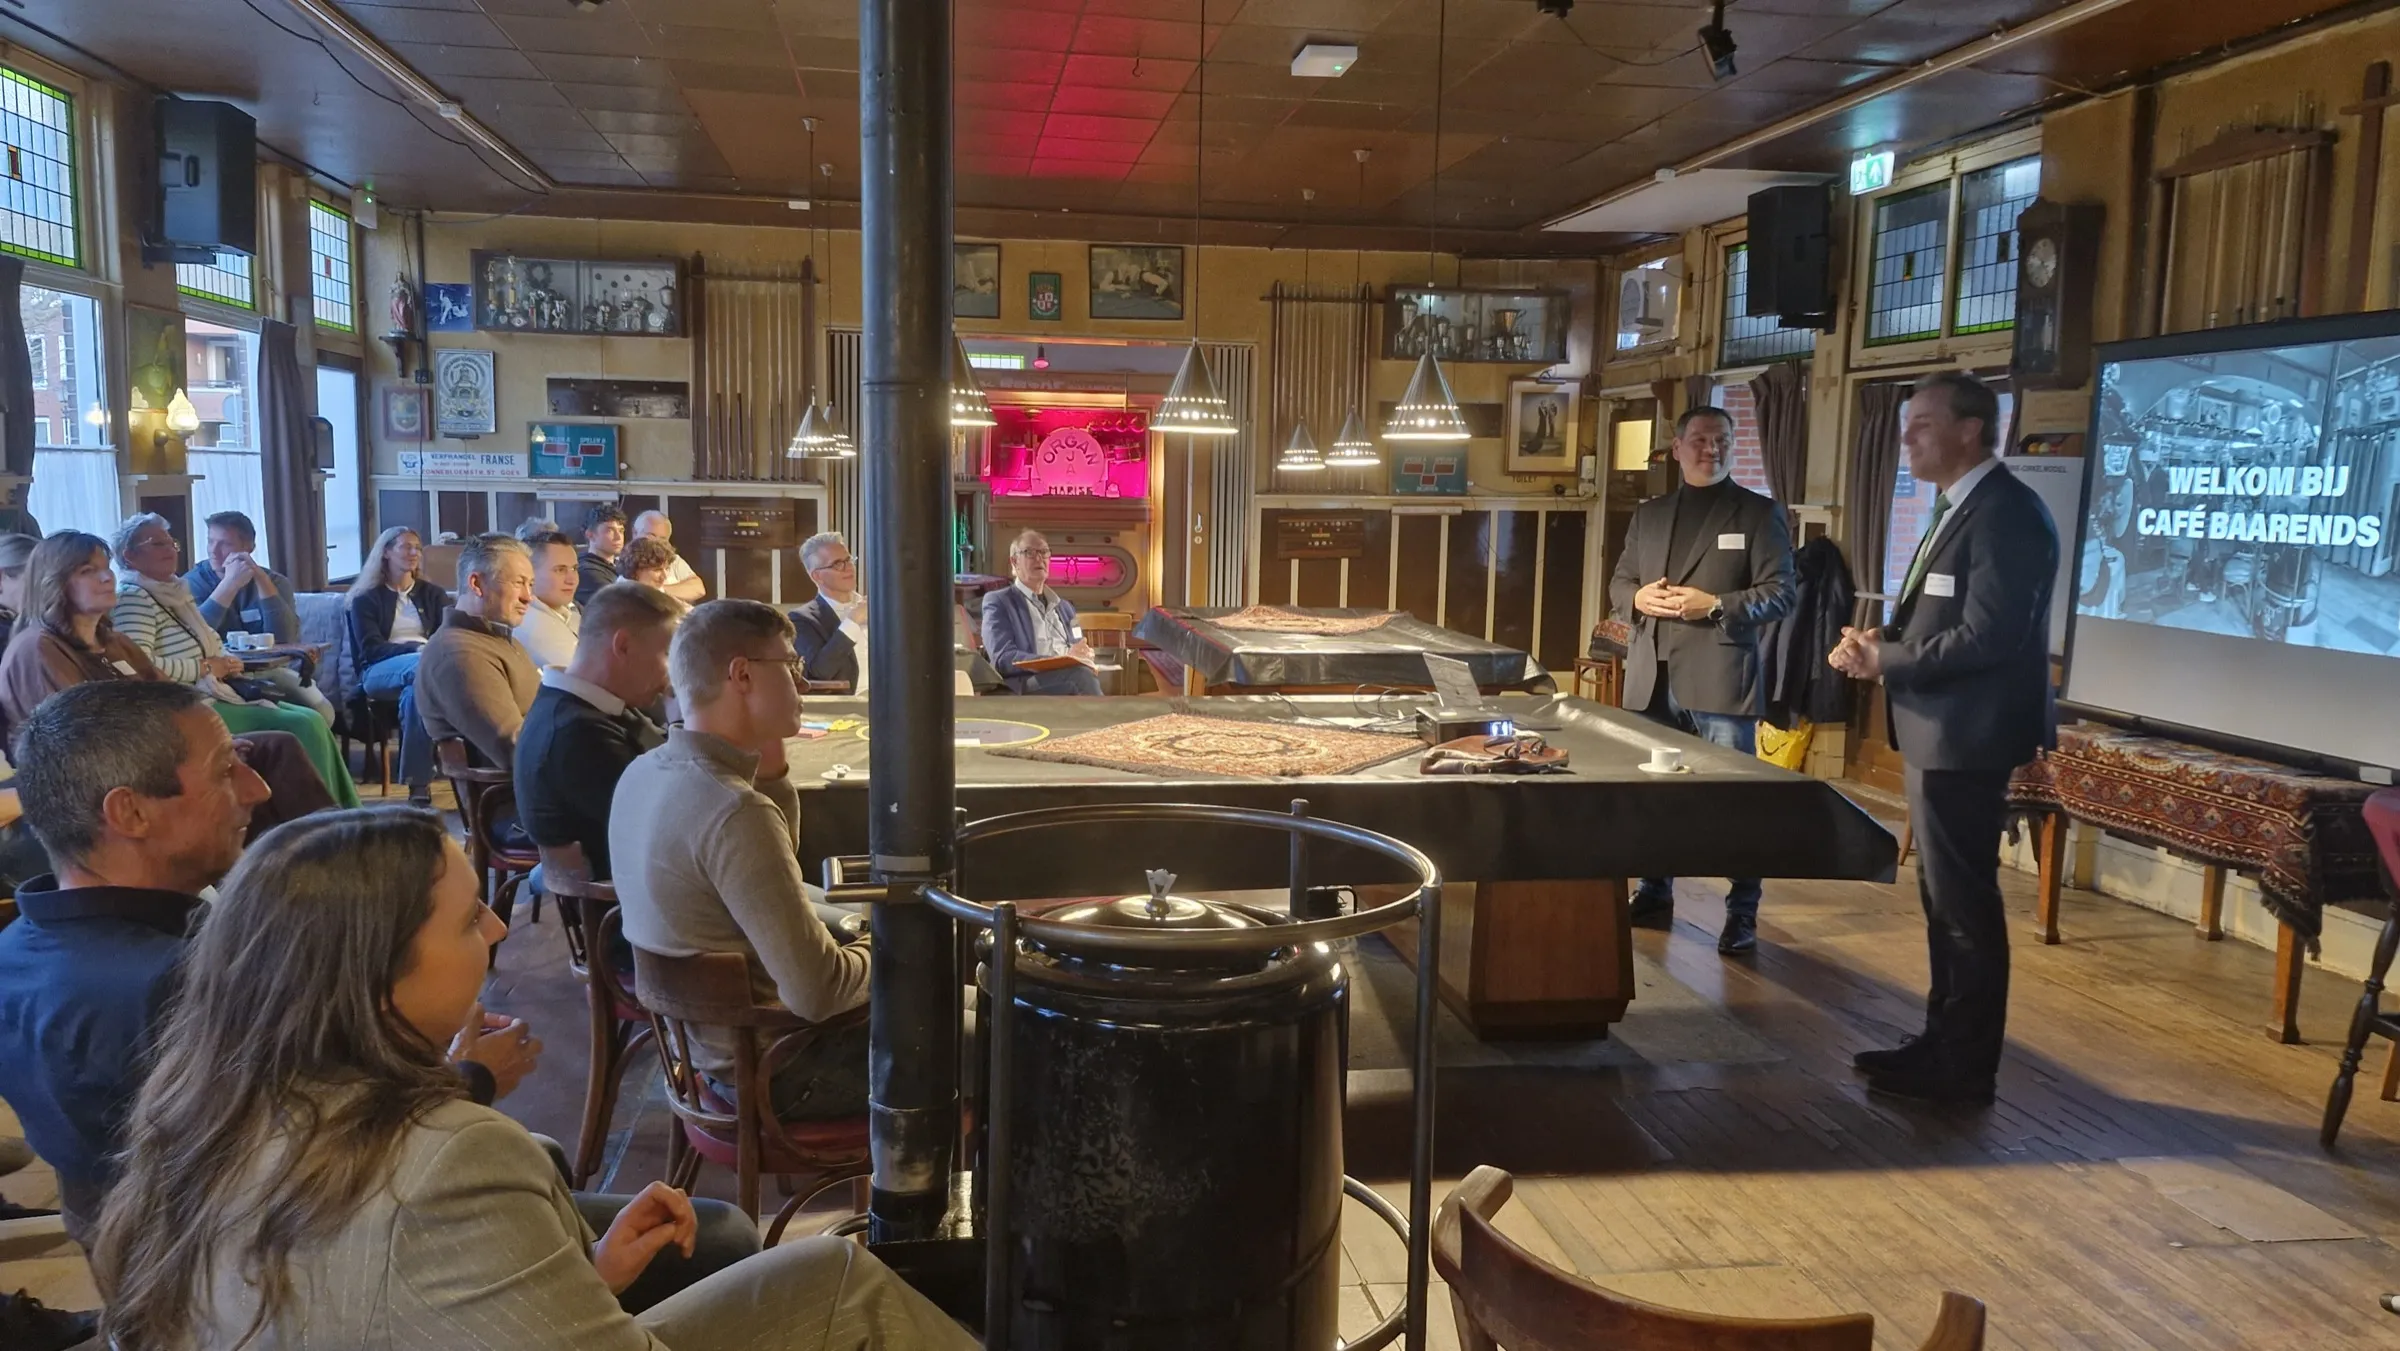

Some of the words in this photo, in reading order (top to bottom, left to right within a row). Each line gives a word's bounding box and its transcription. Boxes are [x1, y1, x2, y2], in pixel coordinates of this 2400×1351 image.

[480, 454, 515, 466] FRANSE
[1043, 434, 1100, 466] ORGAN
[1512, 475, 1538, 483] TOILET
[2168, 466, 2295, 496] WELKOM
[2301, 465, 2349, 497] BIJ
[2137, 504, 2207, 539] CAFÉ
[2208, 511, 2380, 548] BAARENDS
